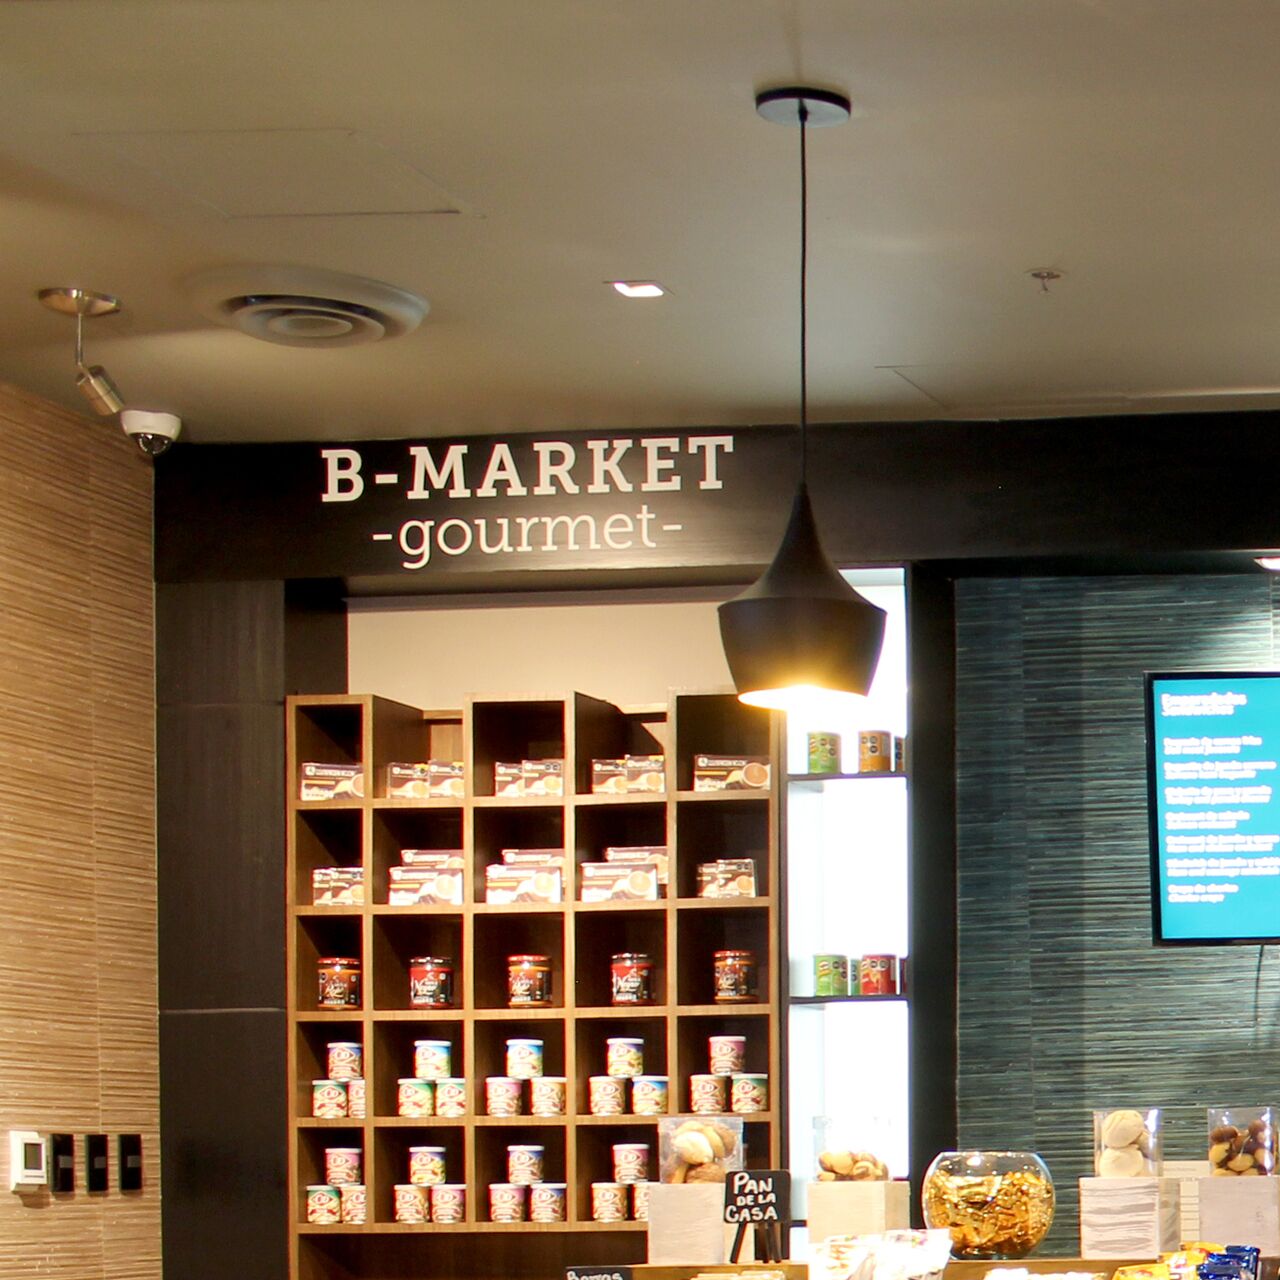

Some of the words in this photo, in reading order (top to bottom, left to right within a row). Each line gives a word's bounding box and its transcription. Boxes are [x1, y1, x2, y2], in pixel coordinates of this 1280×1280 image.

[320, 435, 735, 502] B-MARKET
[372, 503, 684, 570] -gourmet-
[733, 1172, 773, 1194] PAN
[736, 1194, 754, 1206] DE
[758, 1193, 776, 1204] LA
[725, 1205, 778, 1223] CASA
